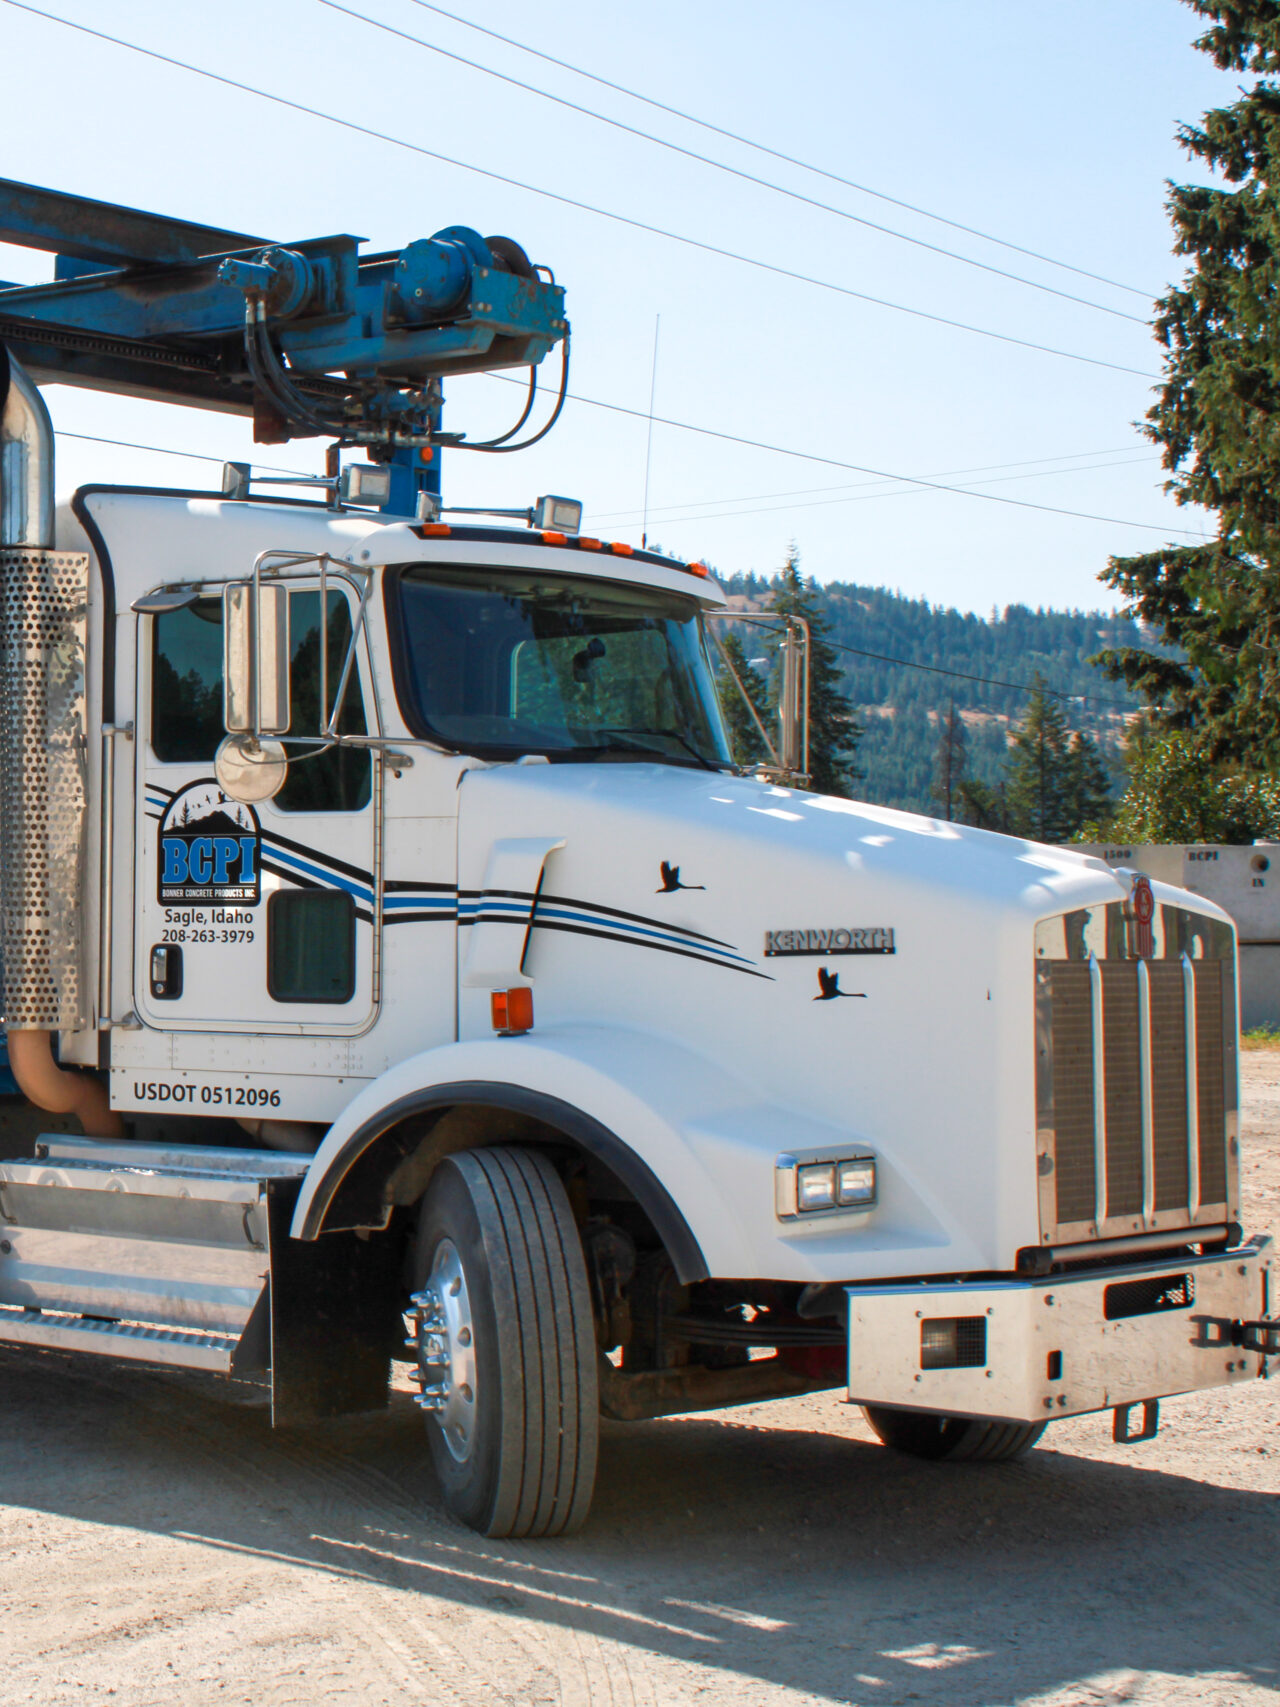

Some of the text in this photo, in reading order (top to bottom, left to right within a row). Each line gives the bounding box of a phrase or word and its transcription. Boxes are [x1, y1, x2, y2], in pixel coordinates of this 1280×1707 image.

[162, 837, 256, 884] BCPI
[1104, 850, 1132, 860] 1500
[1188, 851, 1218, 861] BCPI
[1252, 878, 1265, 887] IN
[162, 888, 184, 898] BONNER
[185, 888, 213, 898] CONCRETE
[214, 888, 243, 898] PRODUCTS
[164, 908, 254, 927] Sagle, Idaho
[161, 929, 255, 943] 208-263-3979
[765, 927, 894, 951] KENWORTH
[134, 1082, 281, 1107] USDOT 0512096
